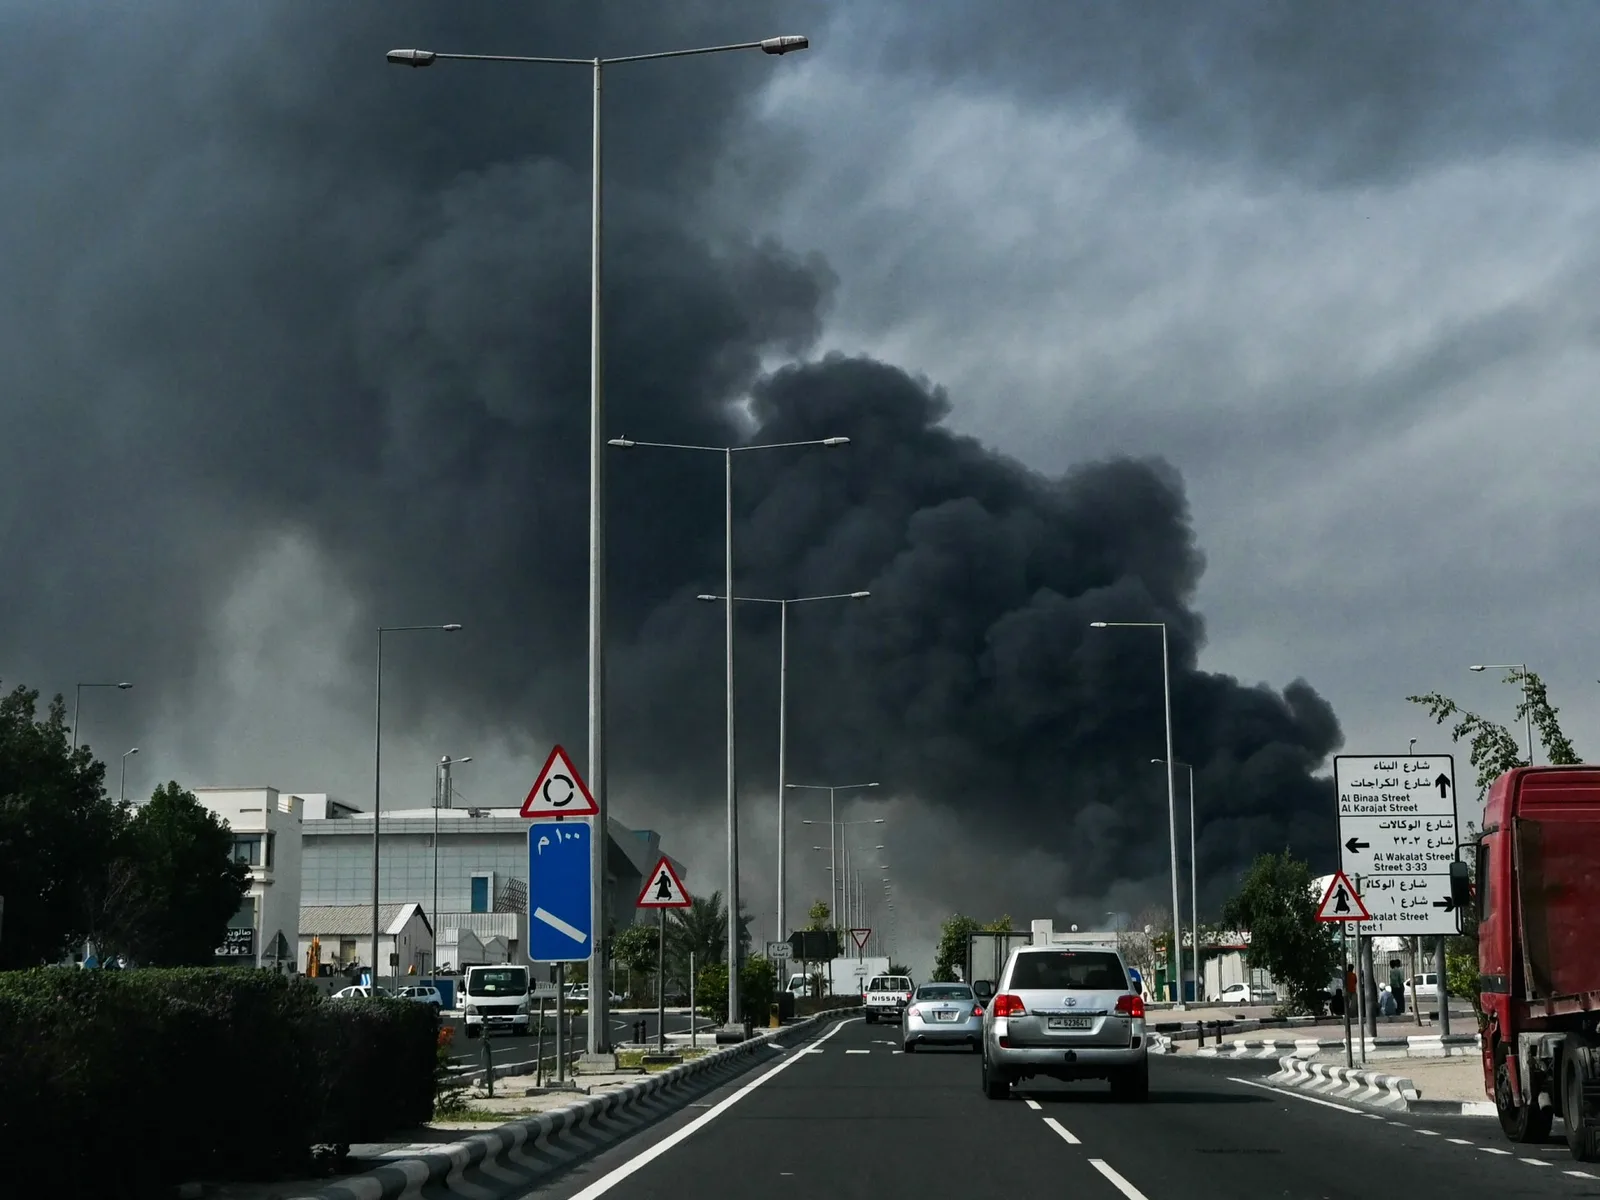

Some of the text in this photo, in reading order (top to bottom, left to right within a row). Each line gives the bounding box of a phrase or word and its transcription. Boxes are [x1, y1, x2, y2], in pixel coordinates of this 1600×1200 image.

[1373, 760, 1430, 773] شارع البناء
[1350, 777, 1431, 790] شارع الكراجات
[1341, 793, 1411, 802] Al Binaa Street
[1341, 803, 1418, 813] Al Karajat Street
[1379, 819, 1453, 832] شارع الوكالات
[537, 835, 550, 856] م
[1427, 836, 1454, 848] شارع
[1373, 852, 1455, 861] Al Wakalat Street
[1374, 862, 1428, 871] Street 3-33
[1400, 878, 1427, 891] شارع
[1390, 895, 1428, 909] شارع ١
[1369, 912, 1429, 921] akalat Street
[1379, 923, 1383, 931] 1
